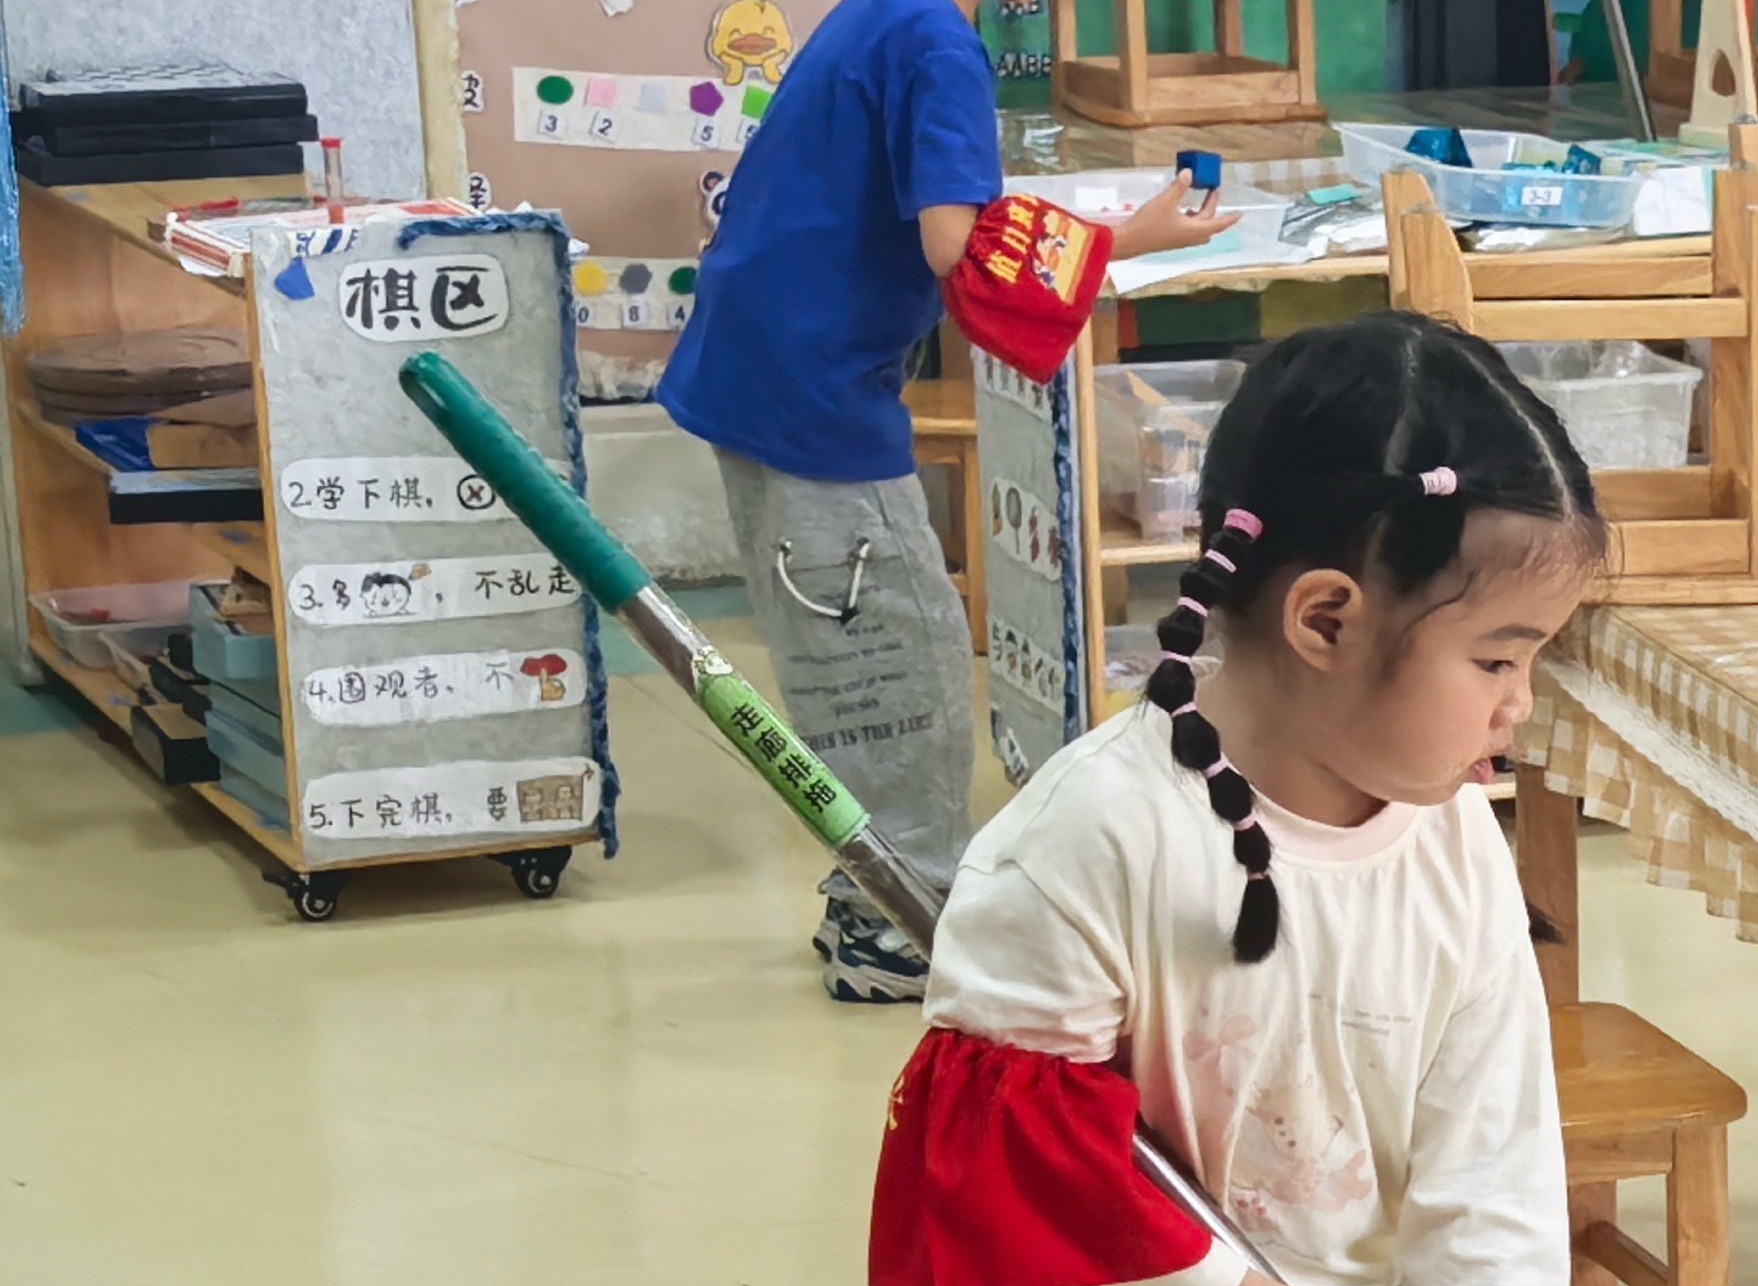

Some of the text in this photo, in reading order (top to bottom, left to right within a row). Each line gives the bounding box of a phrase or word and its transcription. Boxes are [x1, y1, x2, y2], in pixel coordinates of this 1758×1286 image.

[545, 115, 557, 132] 3
[598, 118, 613, 136] 2
[700, 125, 714, 142] 5
[345, 264, 499, 331] 棋区
[675, 305, 685, 321] 4
